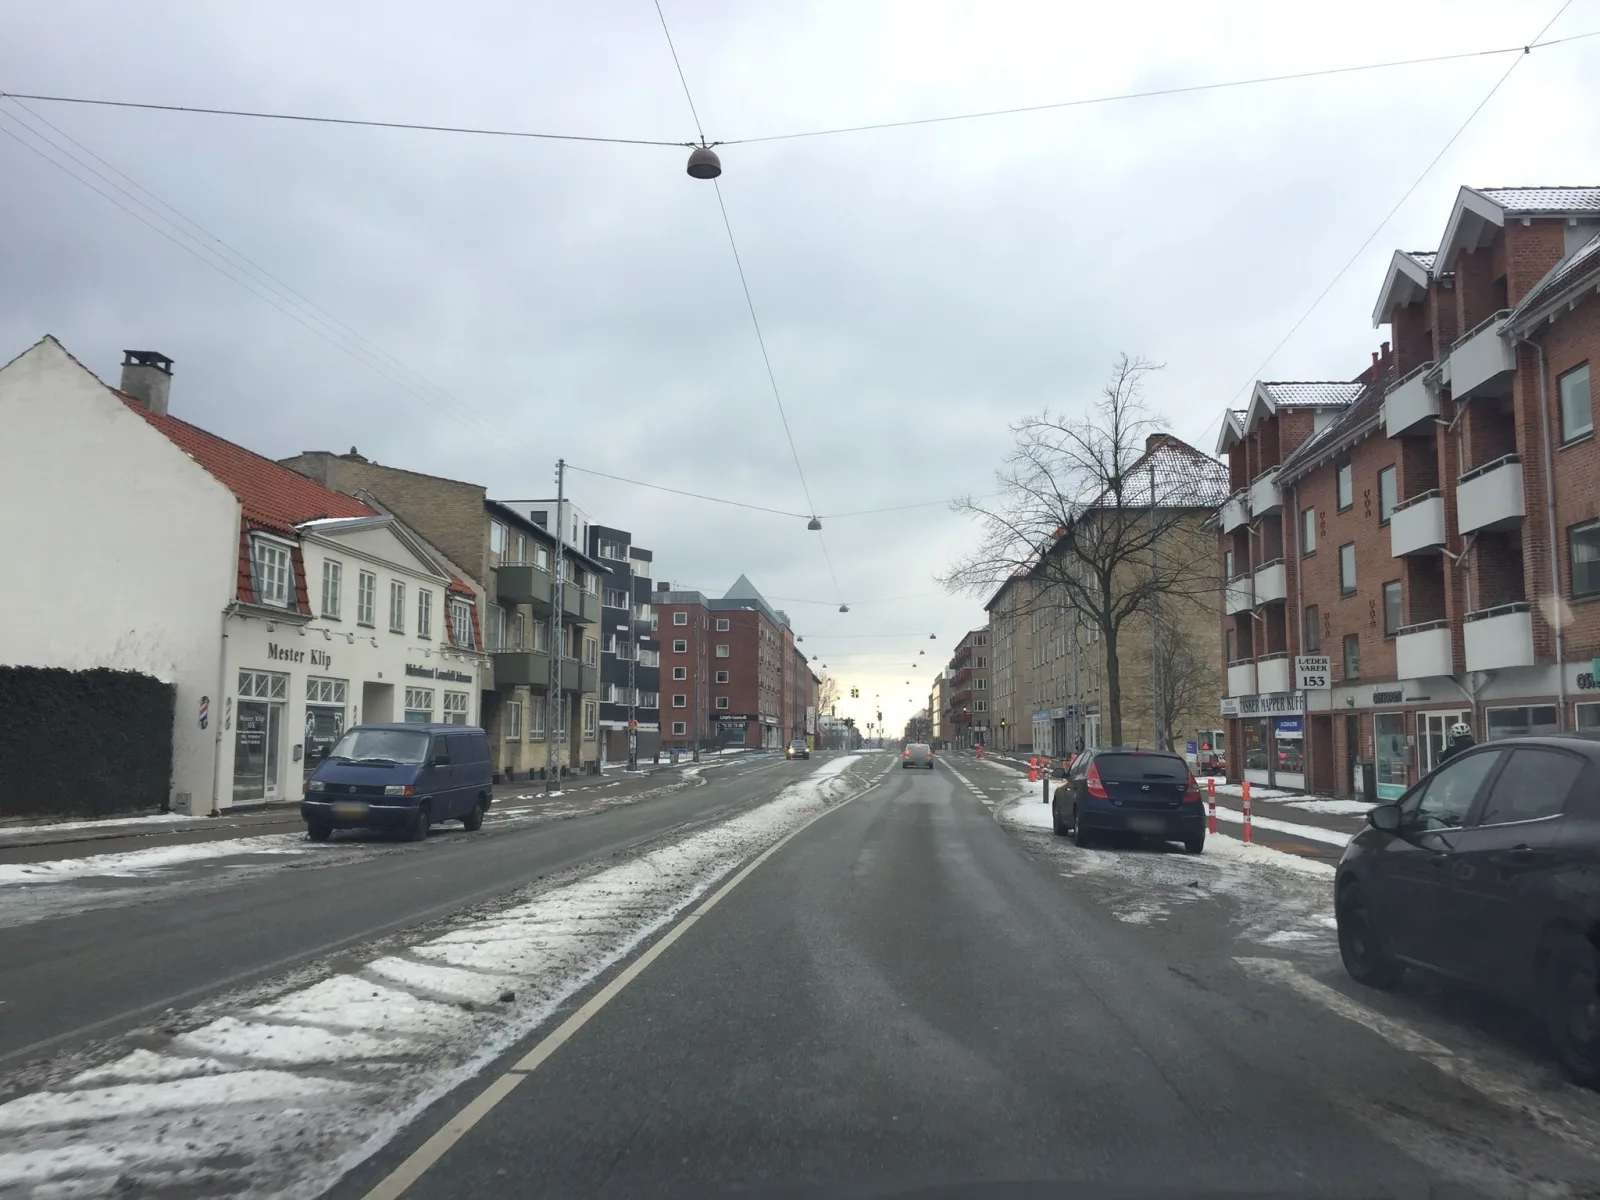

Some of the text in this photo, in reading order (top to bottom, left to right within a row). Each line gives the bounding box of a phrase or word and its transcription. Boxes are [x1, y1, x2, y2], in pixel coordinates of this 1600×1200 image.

[268, 642, 331, 671] Mester Klip
[1303, 676, 1325, 687] 153
[1260, 697, 1286, 712] MAPPER
